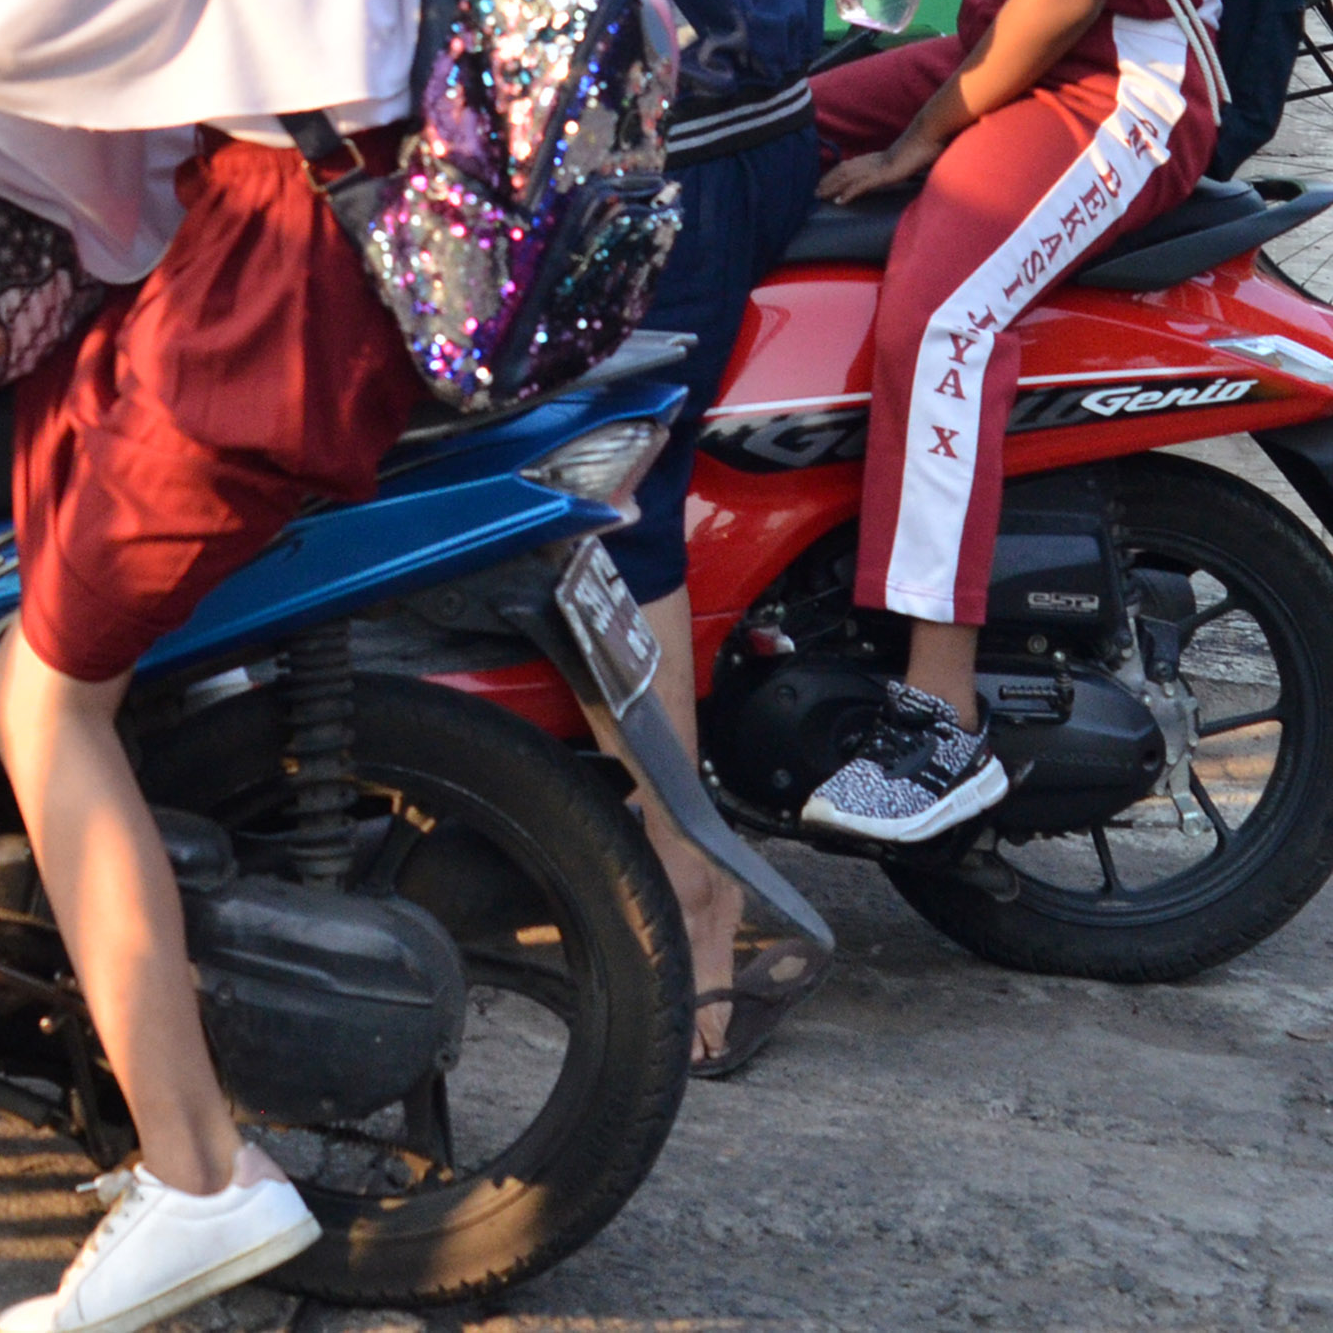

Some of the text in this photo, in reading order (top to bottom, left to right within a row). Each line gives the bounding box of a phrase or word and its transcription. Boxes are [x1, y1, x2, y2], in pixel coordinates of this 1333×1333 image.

[935, 302, 1000, 401] JYA
[1081, 378, 1259, 417] Genio
[927, 423, 962, 460] X
